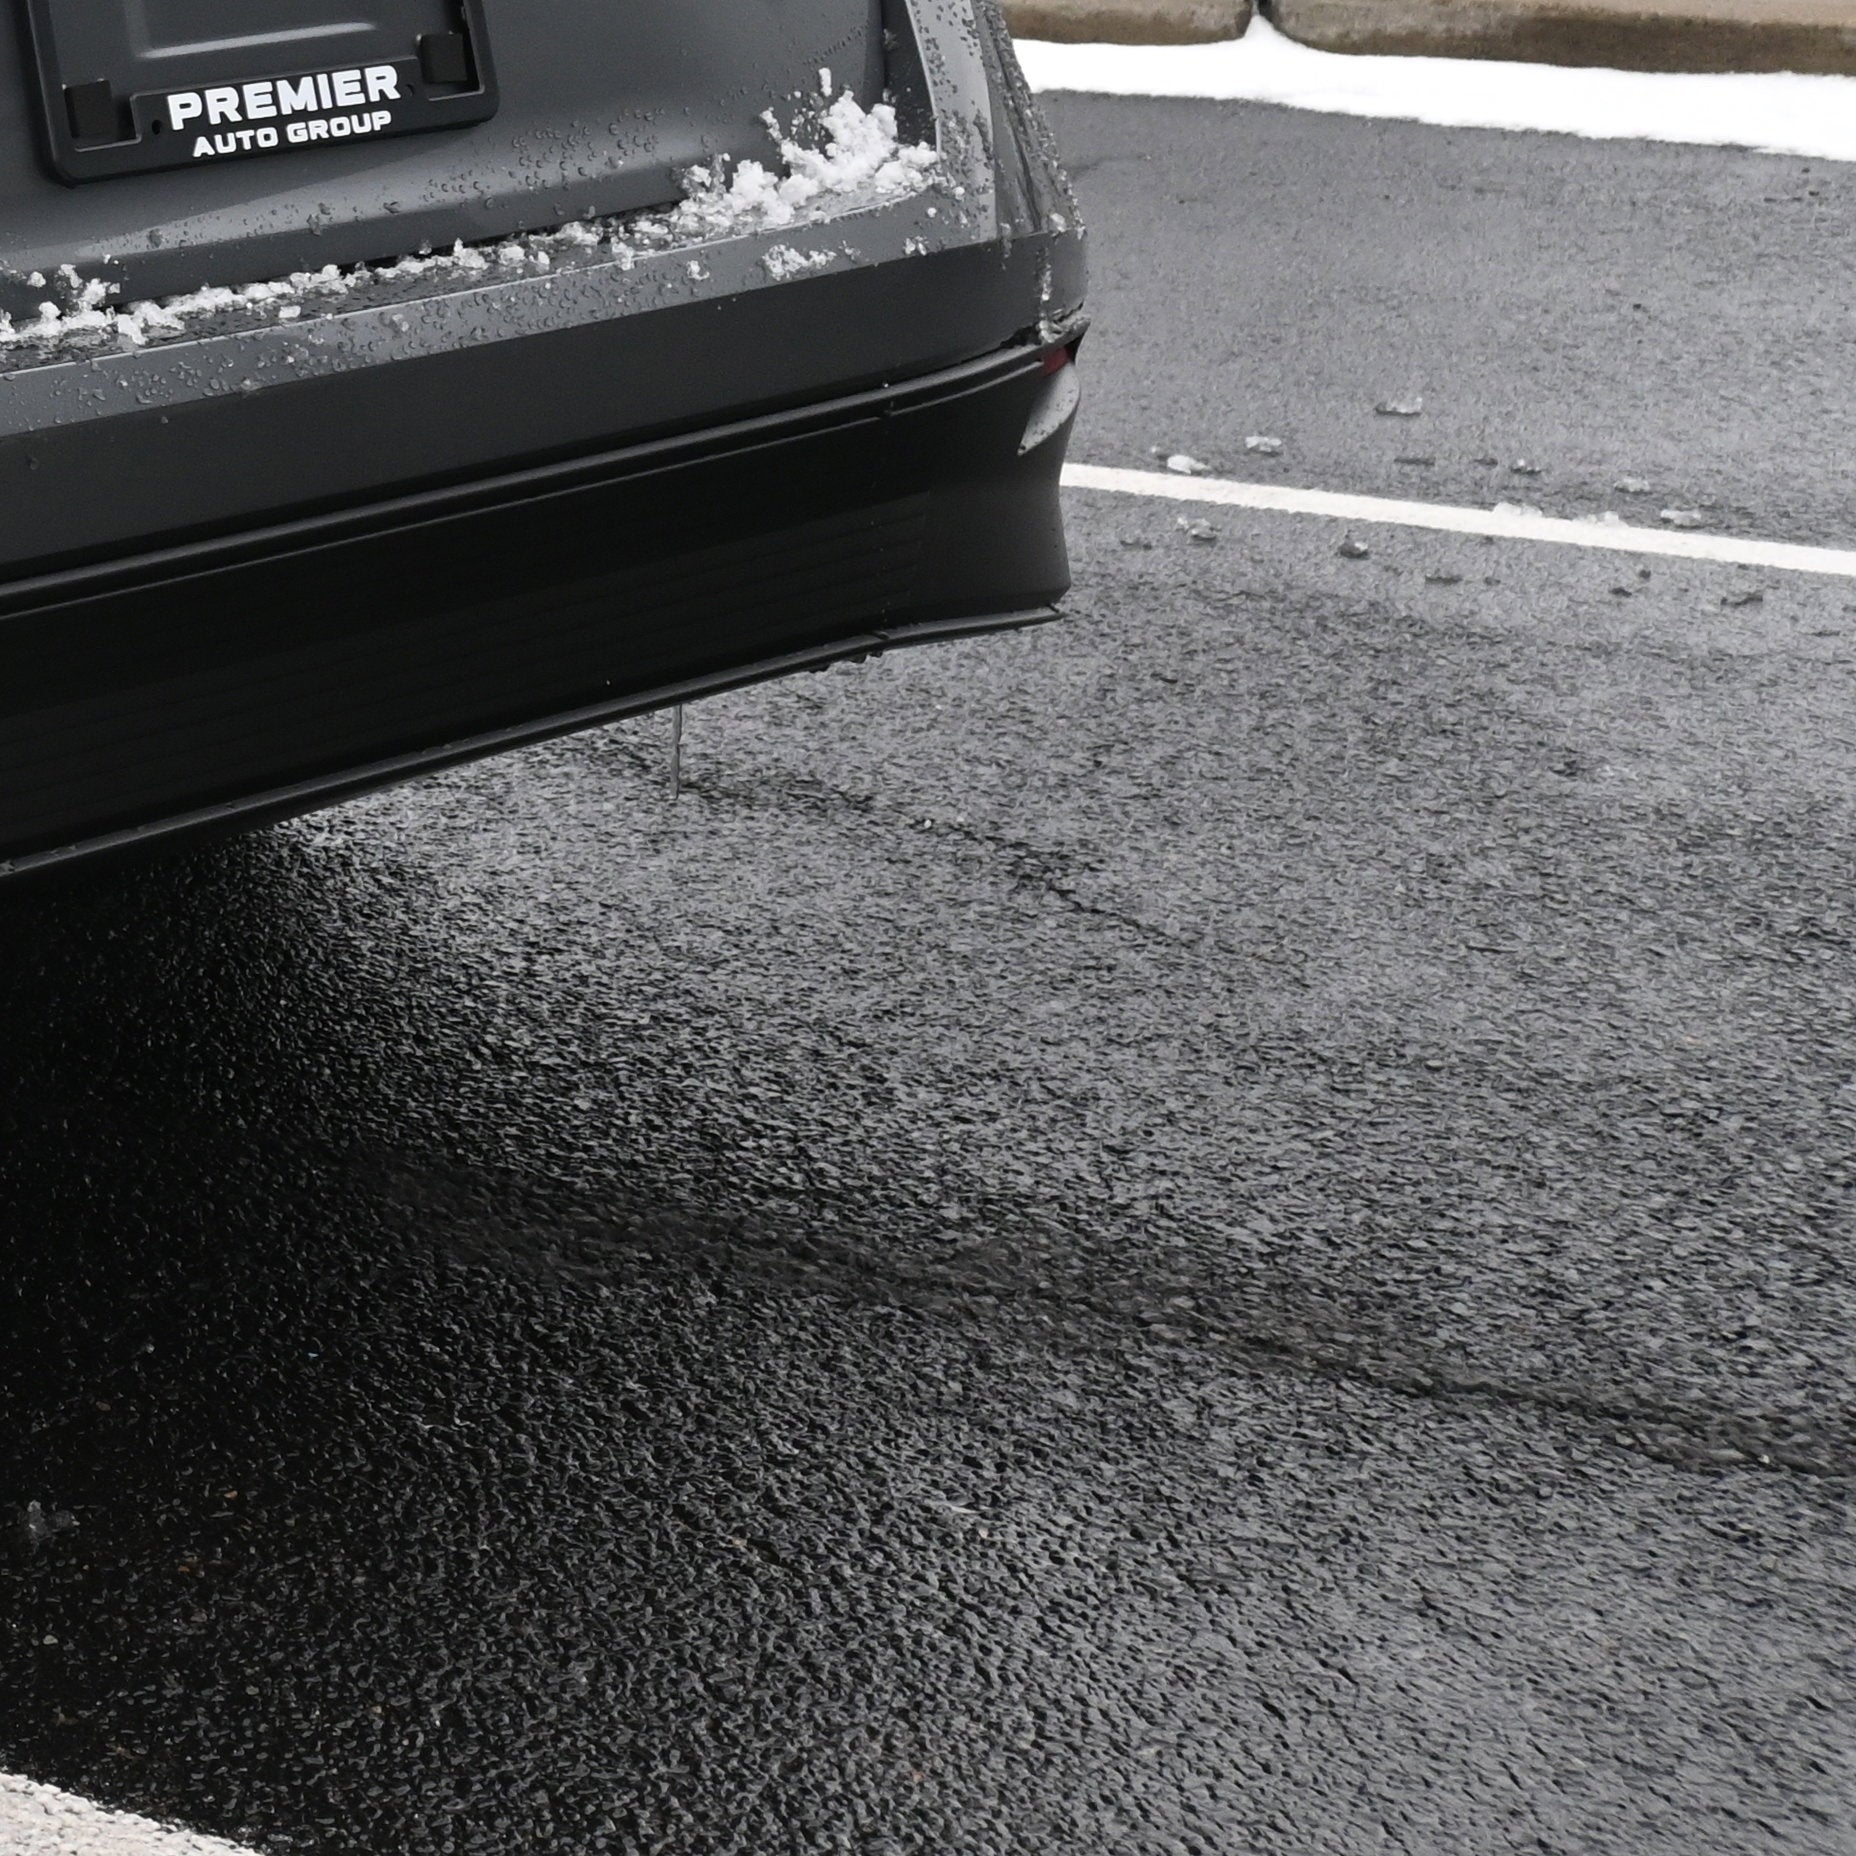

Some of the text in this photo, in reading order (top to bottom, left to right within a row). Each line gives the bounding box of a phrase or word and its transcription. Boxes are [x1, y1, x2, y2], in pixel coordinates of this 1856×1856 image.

[167, 64, 401, 131] PREMIER
[192, 110, 392, 158] AUTO GROUP
